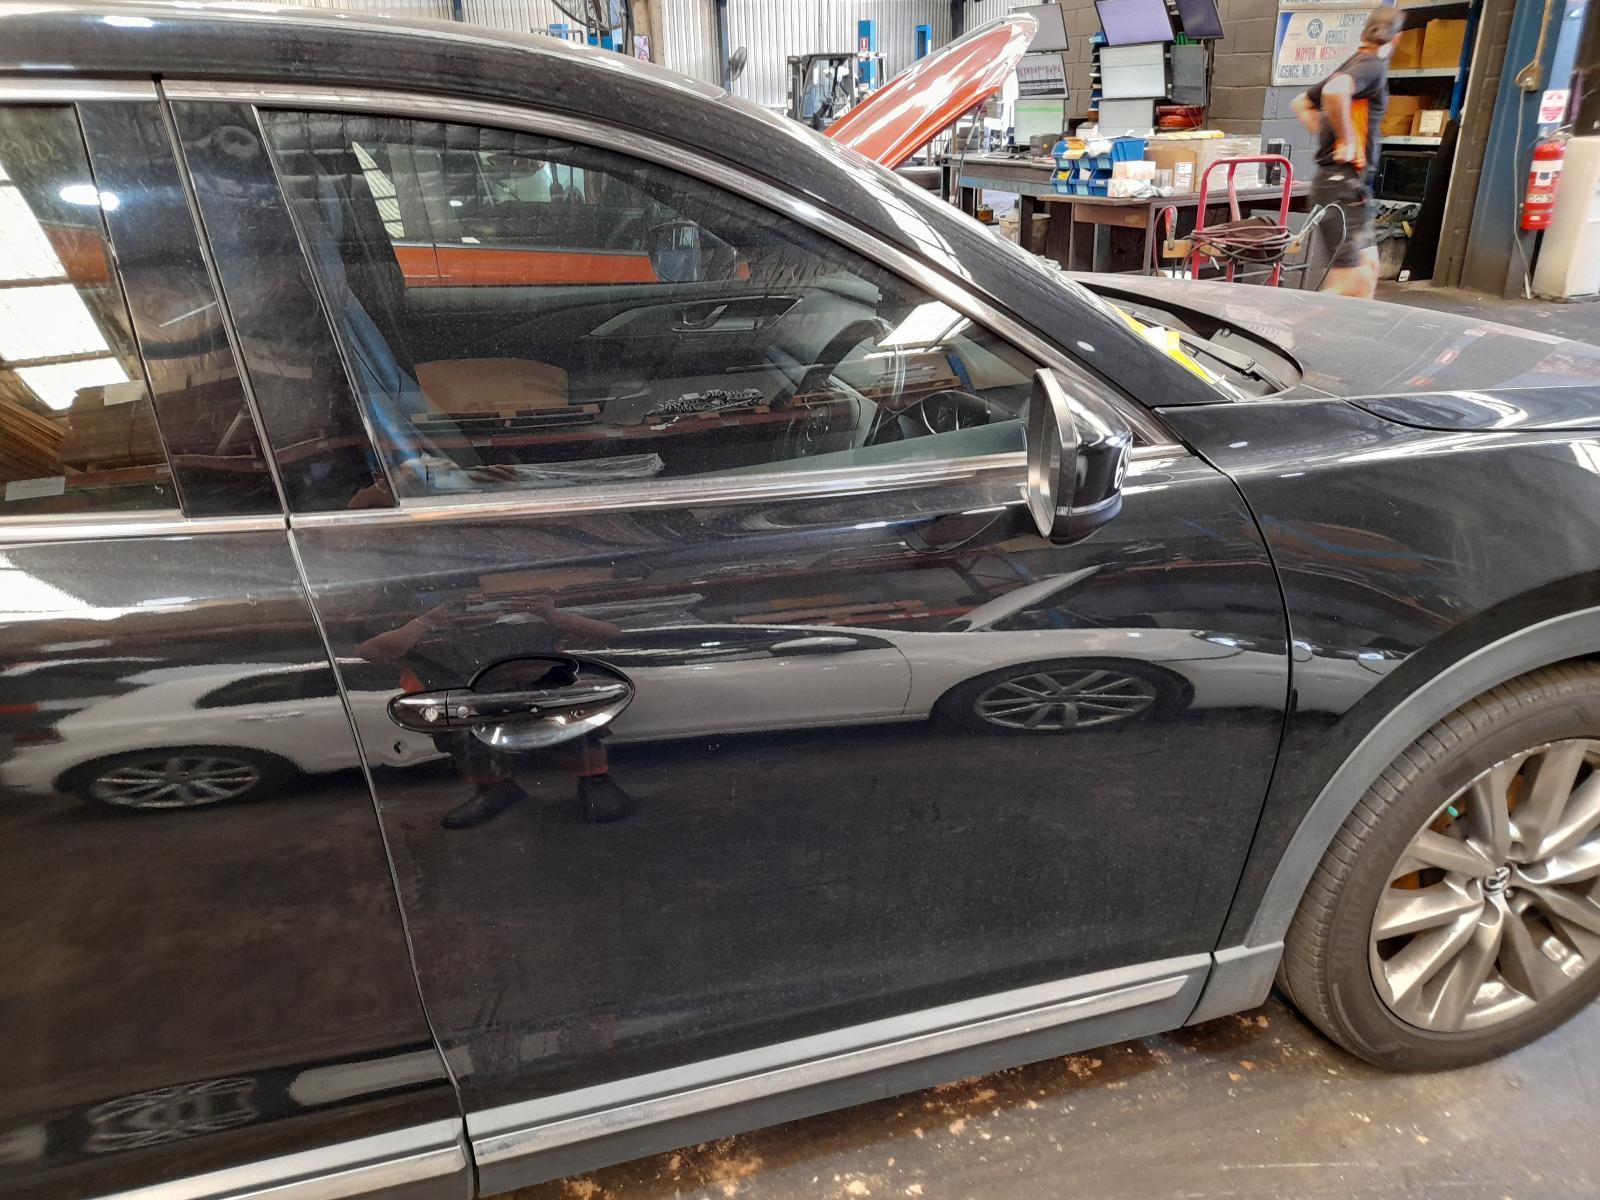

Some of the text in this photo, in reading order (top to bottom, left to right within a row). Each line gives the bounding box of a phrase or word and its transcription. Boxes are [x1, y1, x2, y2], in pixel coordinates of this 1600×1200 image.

[1325, 30, 1348, 44] VEHICLE
[1295, 47, 1316, 62] MOTOR
[1277, 64, 1299, 78] LICENCE
